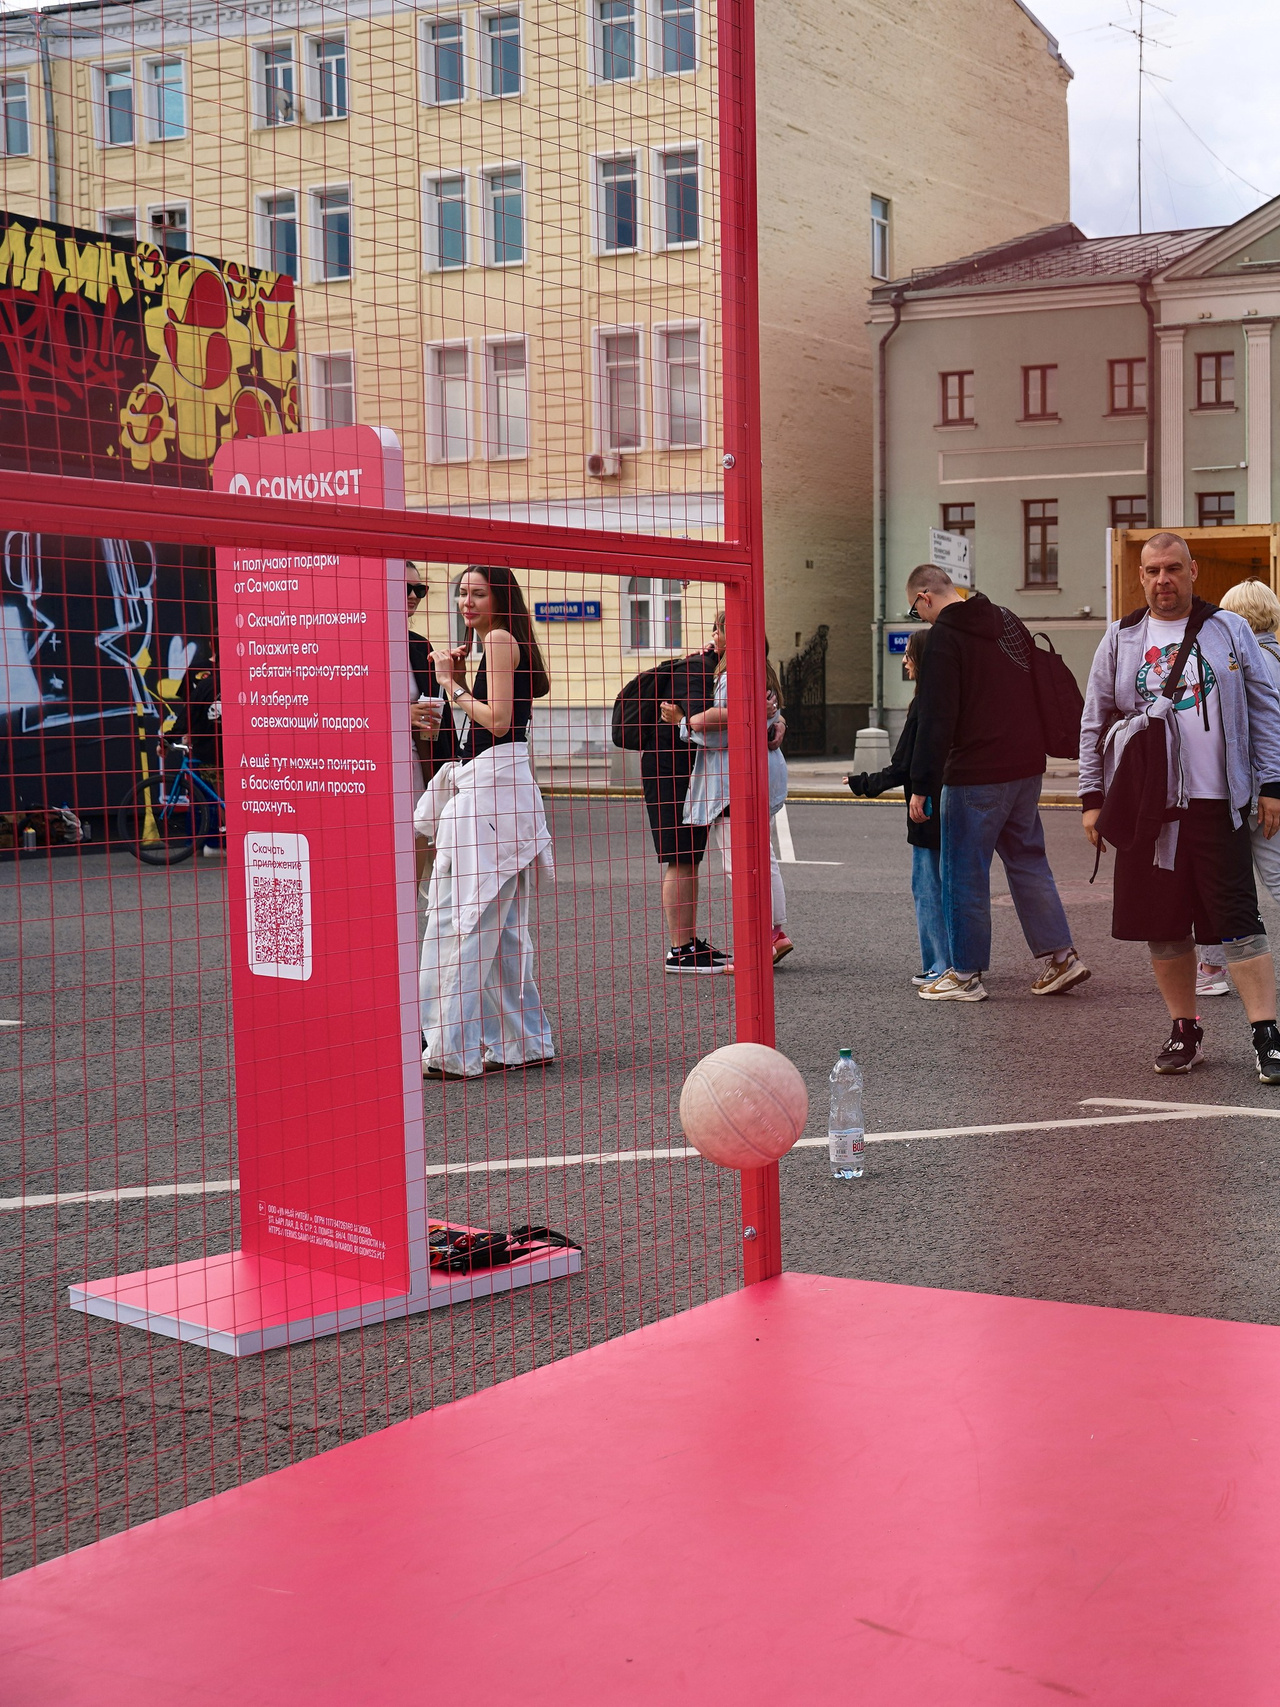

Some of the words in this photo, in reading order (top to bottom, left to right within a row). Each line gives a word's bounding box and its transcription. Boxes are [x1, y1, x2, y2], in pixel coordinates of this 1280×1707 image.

[256, 468, 363, 500] самокат
[233, 560, 240, 571] и
[242, 557, 292, 572] получают
[294, 554, 340, 570] подарки
[234, 582, 245, 593] от
[246, 578, 298, 593] Самоката
[540, 605, 578, 614] БОЛОТНАЯ
[586, 605, 595, 614] 18
[247, 611, 297, 627] Скачайте
[299, 612, 367, 629] приложение
[248, 641, 299, 655] Покажите
[301, 643, 319, 655] его
[249, 662, 369, 681] ребятам-промоутерам
[250, 691, 258, 706] И
[260, 690, 309, 710] заберите
[251, 713, 319, 730] освежающий
[322, 716, 369, 732] подарок
[240, 753, 248, 767] А
[249, 754, 270, 770] ещё
[272, 757, 287, 772] тут
[289, 758, 325, 770] можно
[327, 759, 377, 774] поиграть
[241, 778, 247, 789] в
[249, 775, 303, 791] баскетбол
[305, 781, 325, 793] или
[327, 781, 365, 796] просто
[242, 801, 296, 816] отдохнуть.
[252, 842, 285, 855] Скачать
[252, 858, 302, 871] приложение
